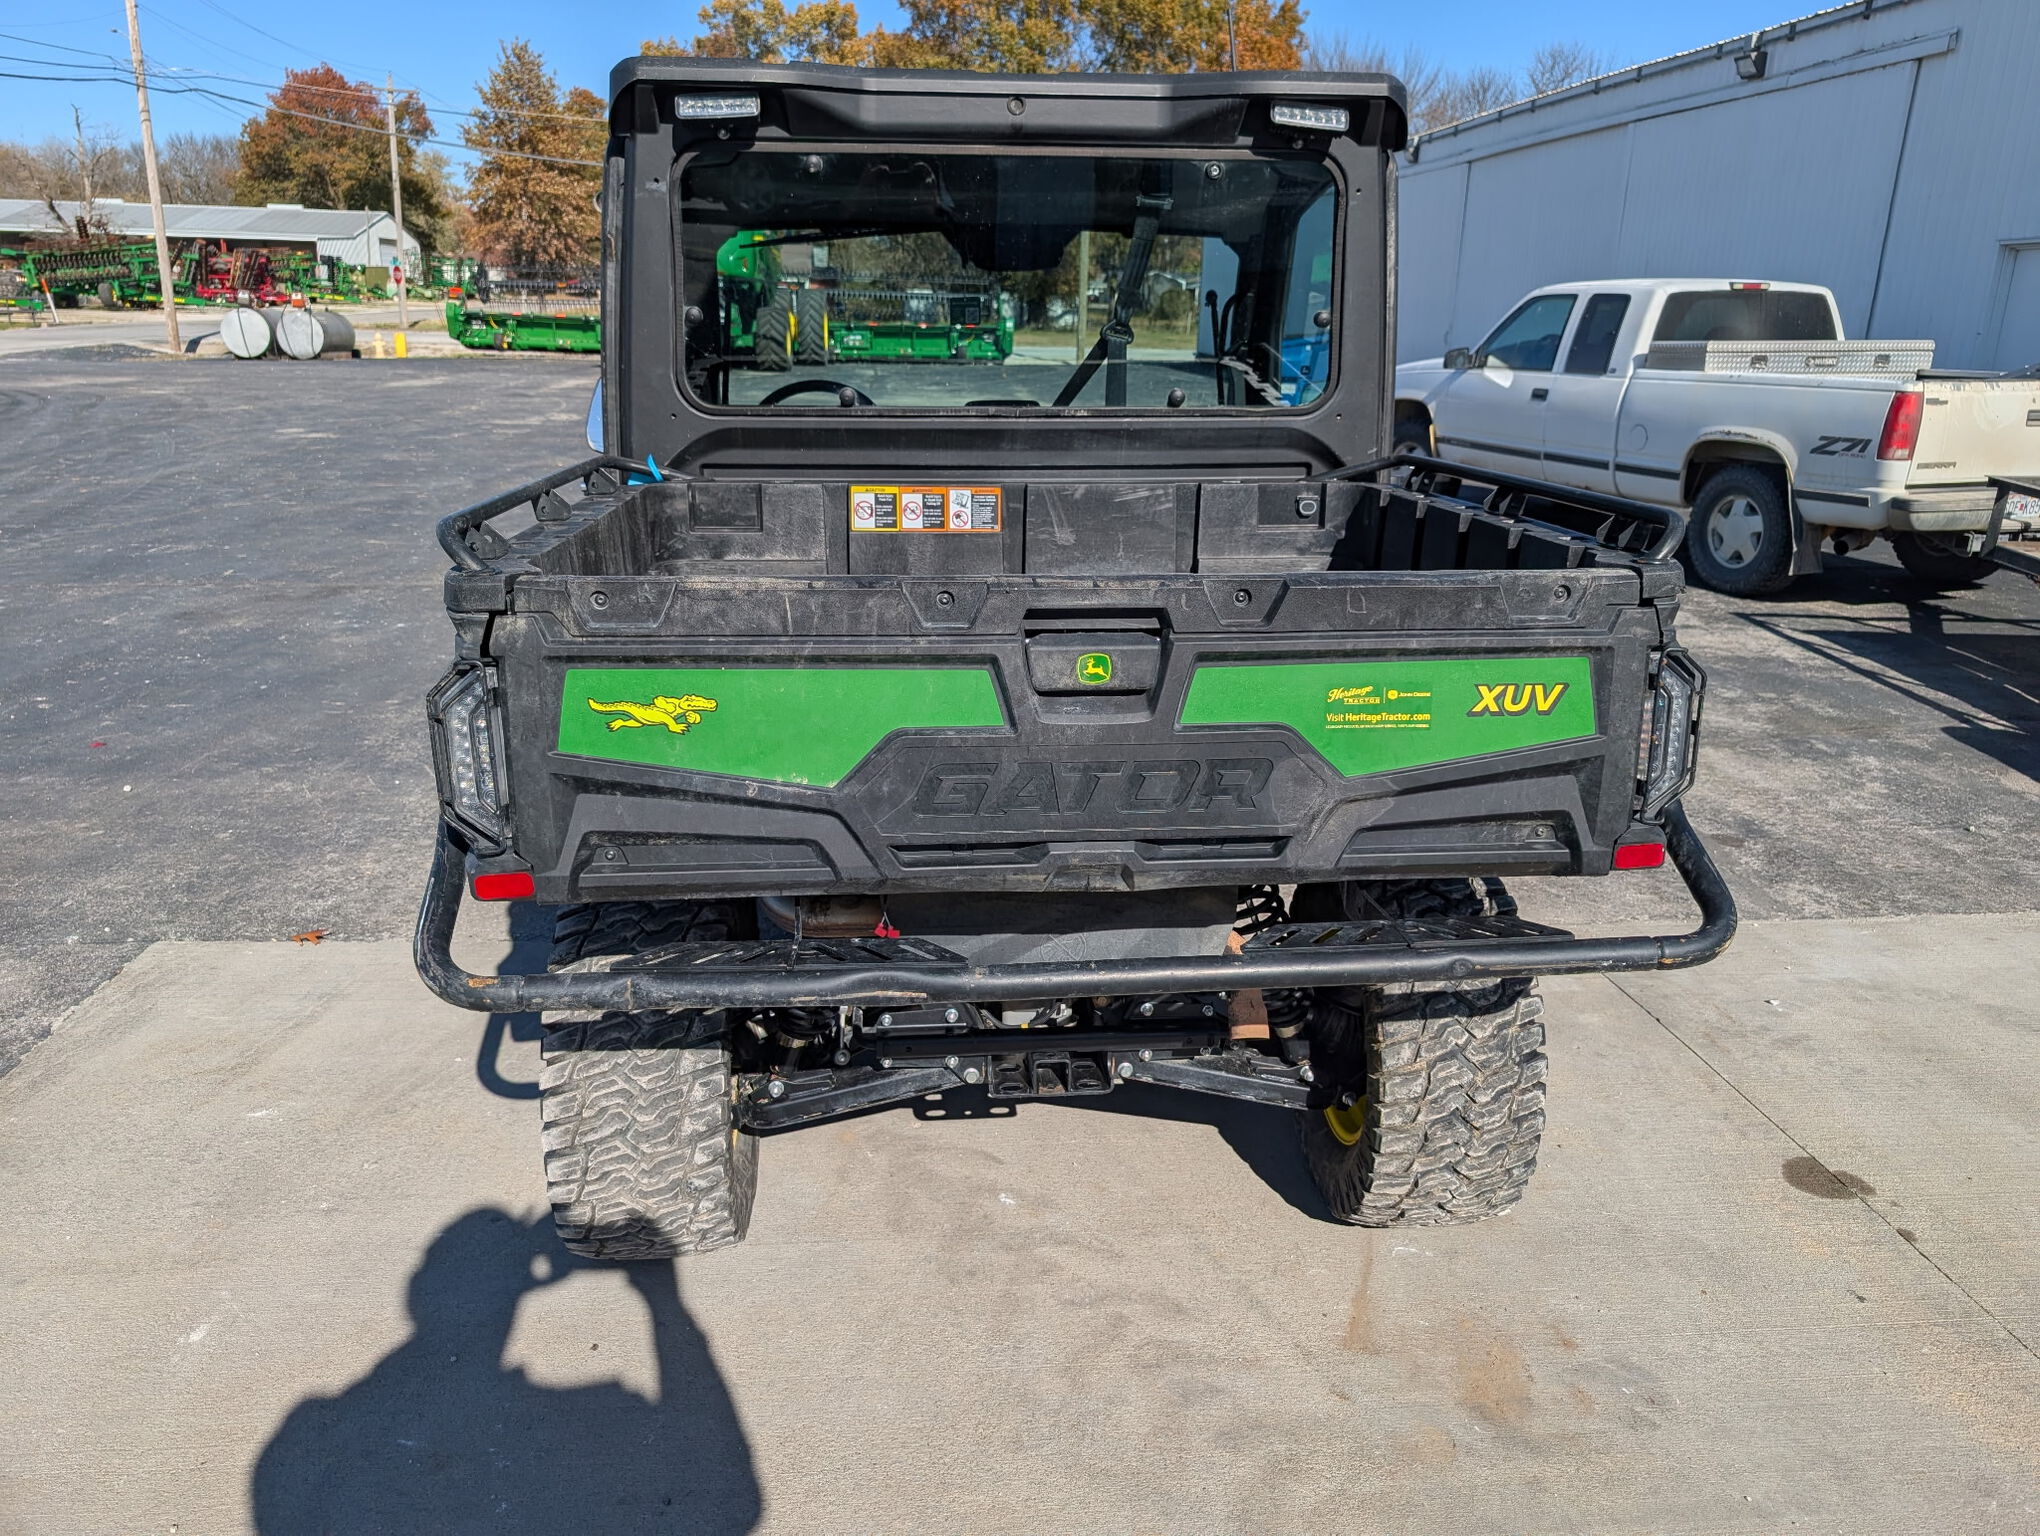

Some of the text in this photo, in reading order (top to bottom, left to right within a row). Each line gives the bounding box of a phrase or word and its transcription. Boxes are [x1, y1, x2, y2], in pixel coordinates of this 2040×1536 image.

[1809, 435, 1873, 456] Z71
[1327, 685, 1374, 702] Heritage
[1466, 682, 1570, 717] XUV
[1326, 712, 1431, 723] Visit HeritageTractor.com
[912, 757, 1274, 817] GATOR
